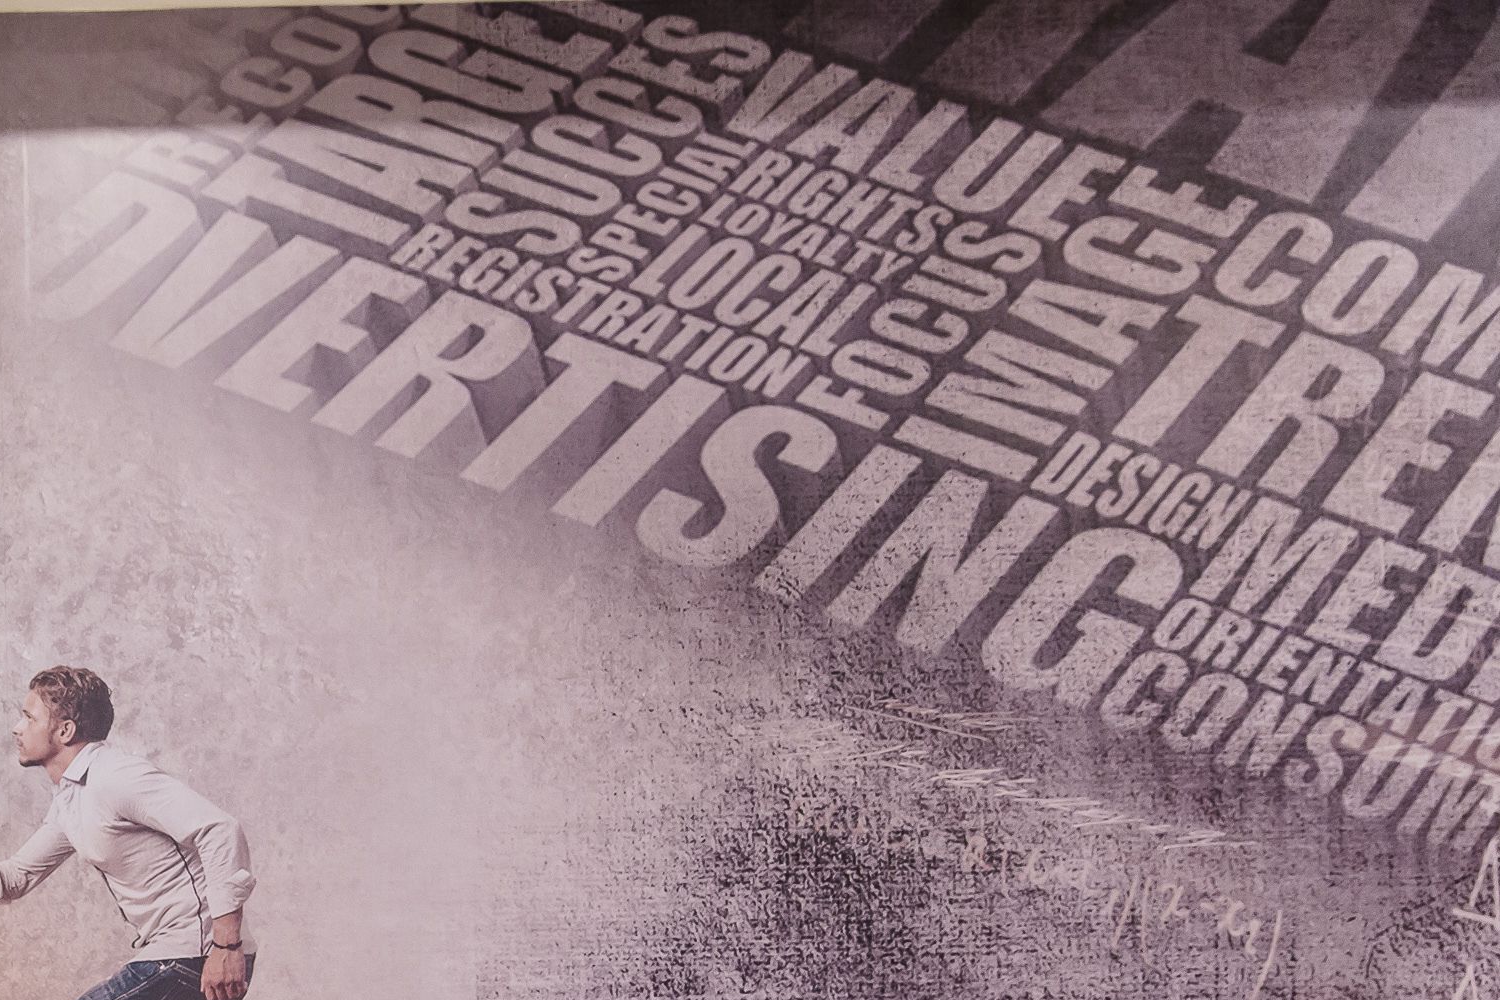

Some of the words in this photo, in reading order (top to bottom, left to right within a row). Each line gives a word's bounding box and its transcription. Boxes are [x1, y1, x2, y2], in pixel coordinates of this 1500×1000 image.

[445, 15, 771, 257] SUCCES
[567, 130, 758, 282] SPECIAL
[726, 49, 1126, 242] VALUE
[729, 149, 954, 254] RIGHTS
[389, 222, 812, 398] REGISTRATION
[628, 223, 877, 358] LOCAL
[698, 193, 916, 287] LOYALTY
[796, 219, 1043, 431] FOCUS
[892, 164, 1258, 483] IMAGE
[1030, 430, 1254, 551] DESIGN
